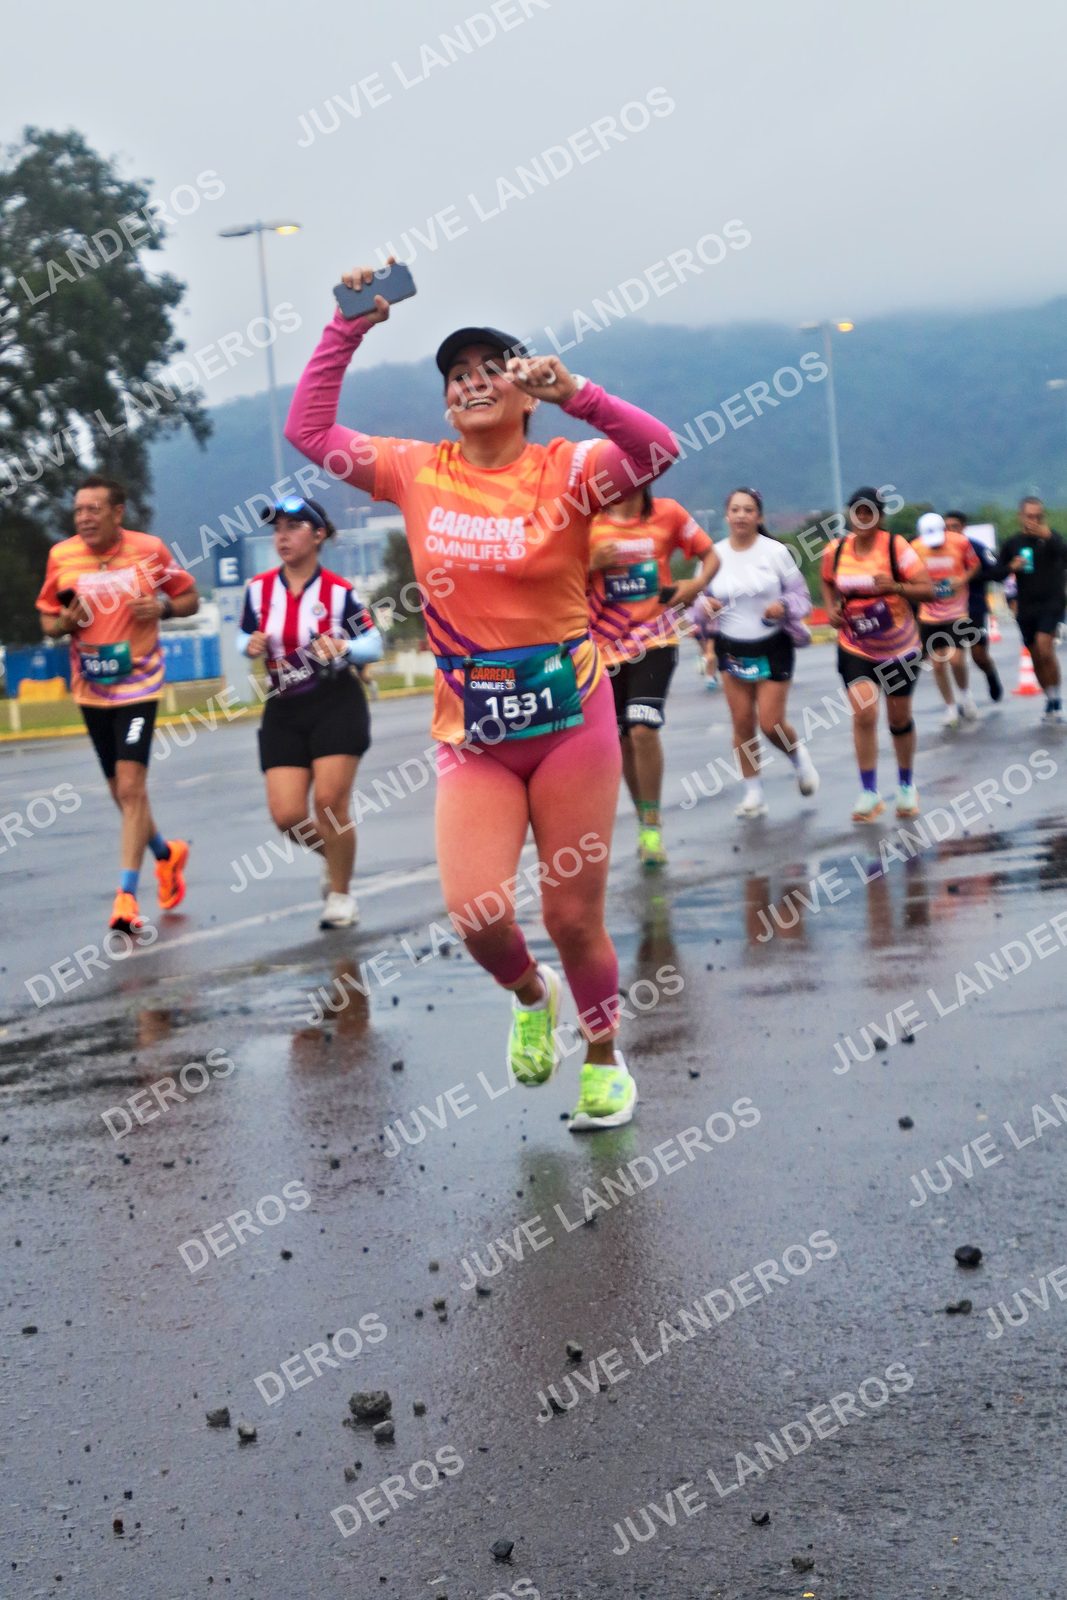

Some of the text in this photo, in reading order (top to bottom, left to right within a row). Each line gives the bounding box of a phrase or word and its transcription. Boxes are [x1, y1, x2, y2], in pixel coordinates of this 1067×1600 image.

[428, 506, 526, 542] CARRERA
[425, 535, 504, 560] OMNILIFE
[218, 557, 240, 584] E
[470, 667, 516, 681] CARRERA
[485, 687, 554, 719] 1531
